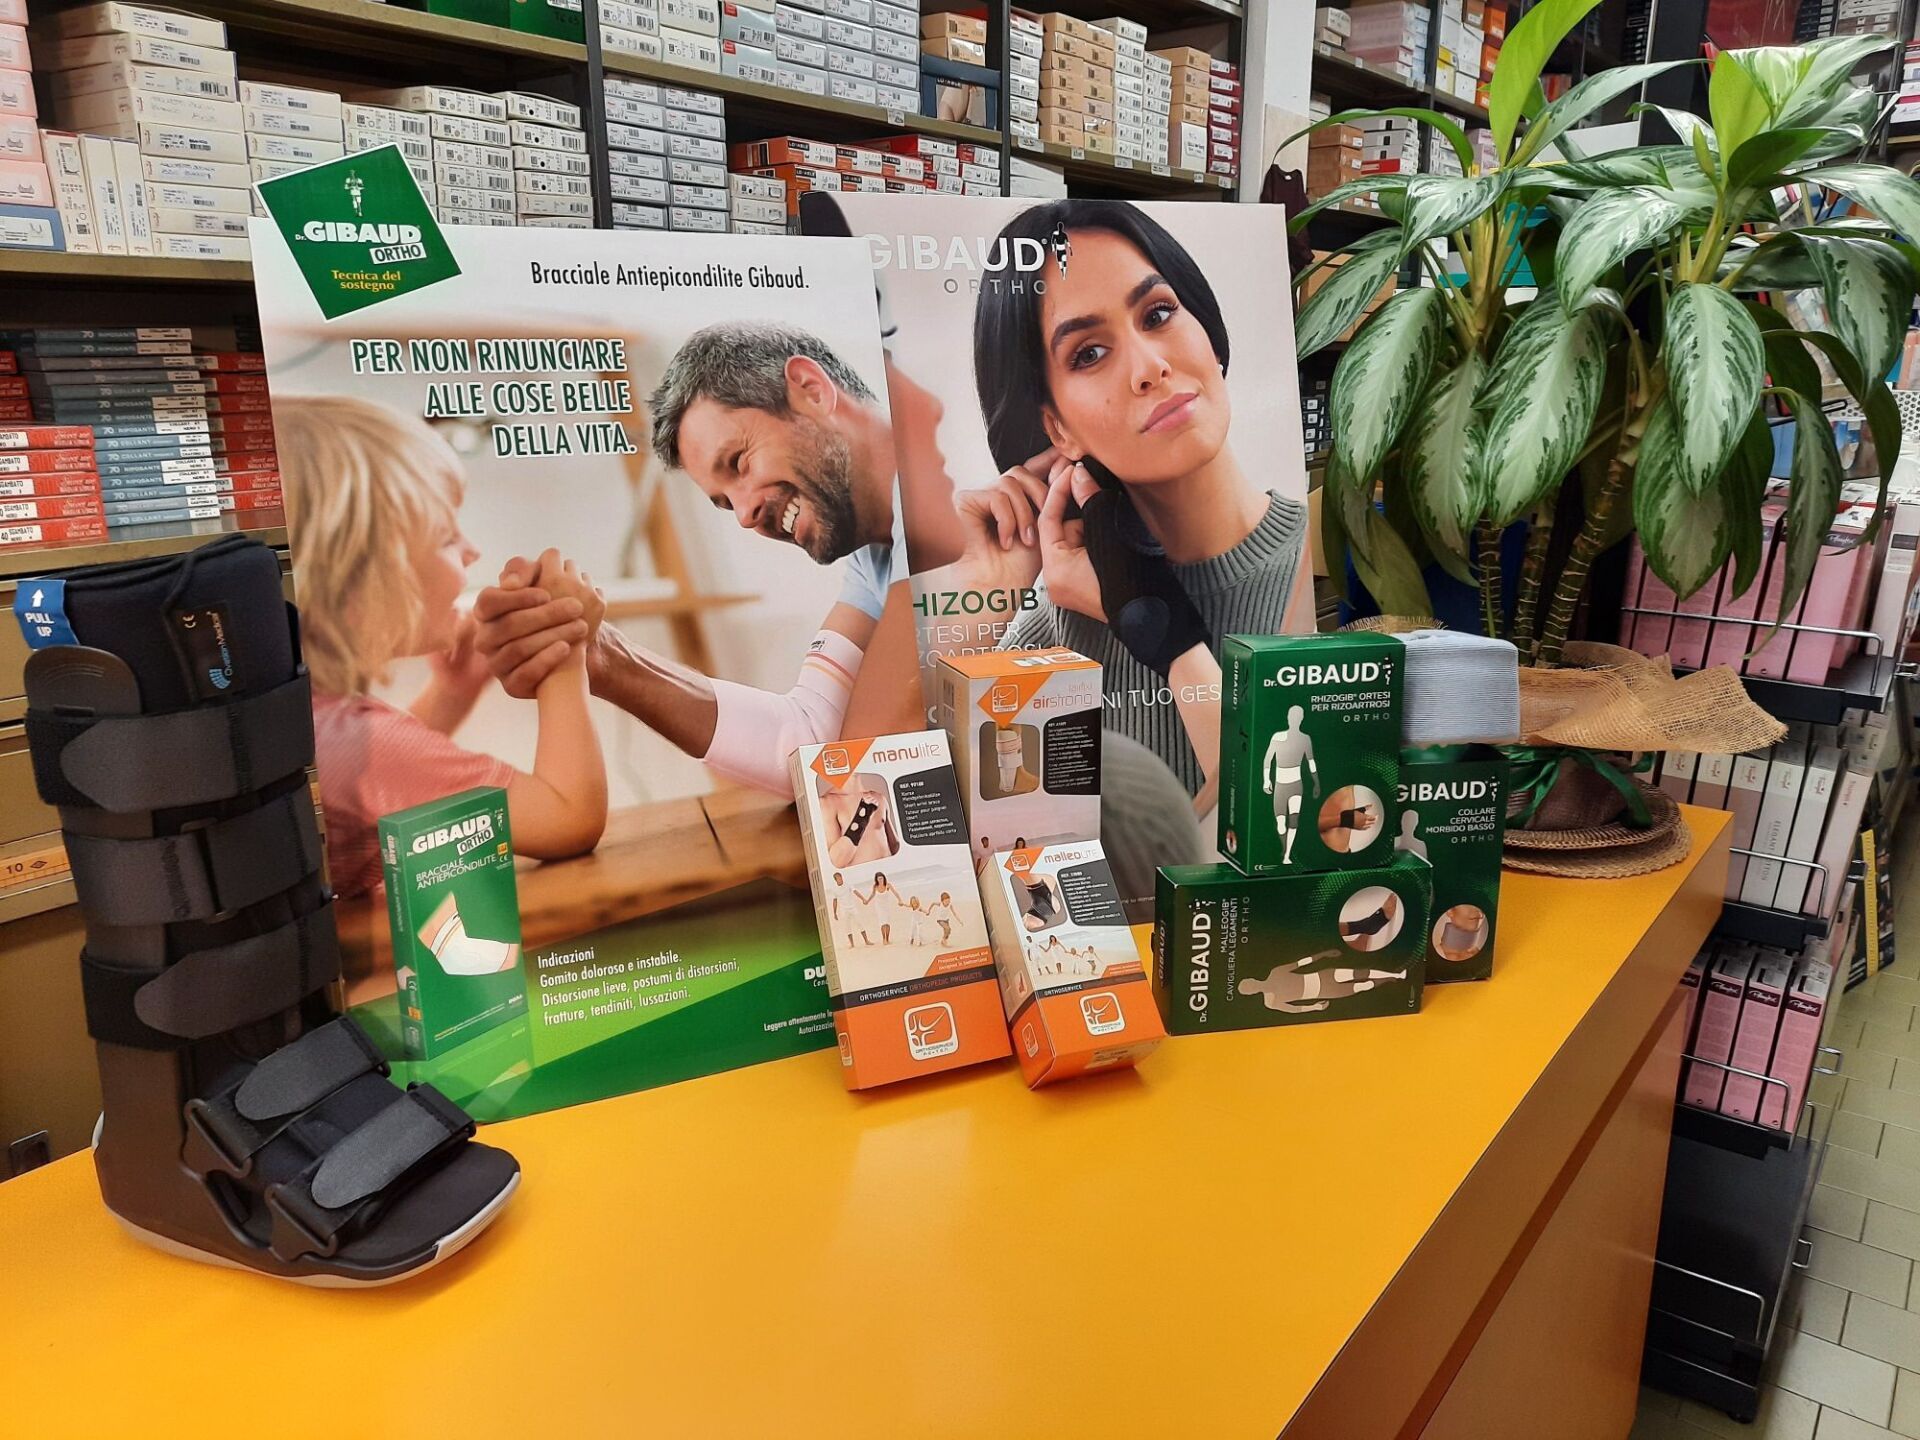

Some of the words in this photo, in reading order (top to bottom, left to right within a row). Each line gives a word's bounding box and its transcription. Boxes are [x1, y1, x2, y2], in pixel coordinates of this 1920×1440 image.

[304, 221, 422, 244] GIBAUD
[374, 244, 422, 262] ORTHO
[864, 233, 1045, 272] GIBAUD
[331, 270, 379, 281] Tecnica
[382, 270, 401, 281] del
[340, 280, 394, 292] sostegno
[531, 262, 610, 286] Bracciale
[616, 264, 742, 292] Antiepicondilite
[748, 266, 810, 290] Gibaud.
[944, 278, 1048, 295] ORTHO
[353, 340, 402, 373] PER
[410, 340, 472, 372] NON
[479, 339, 626, 371] RINUNCIARE
[425, 385, 484, 417] ALLE
[492, 383, 557, 415] COSE
[565, 382, 632, 414] BELLE
[494, 426, 568, 456] DELLA
[575, 424, 637, 455] VITA.
[108, 466, 120, 474] 70
[0, 532, 8, 541] 40
[912, 587, 1039, 617] HIZOGIB
[24, 612, 54, 624] PULL
[37, 626, 52, 637] UP
[977, 621, 1022, 642] PER
[1263, 678, 1278, 688] Dr.
[1276, 662, 1380, 687] GIBAUD
[1033, 693, 1093, 710] airstrong
[1128, 687, 1174, 708] TUO
[1180, 683, 1222, 704] GES
[1311, 702, 1329, 712] PER
[1330, 700, 1390, 712] RIZOARTROSI
[1359, 691, 1391, 701] ORTESI
[1343, 712, 1390, 723] ORTHO
[872, 742, 942, 764] manulite
[1396, 780, 1487, 802] GIBAUD
[1450, 815, 1496, 825] CERVICALE
[1458, 807, 1496, 817] COLLARE
[412, 814, 492, 854] GIBAUD
[1425, 824, 1466, 834] MORBIDO
[1467, 822, 1495, 832] BASSO
[1451, 834, 1494, 844] ORTHO
[460, 829, 492, 853] ORTHO
[6, 862, 24, 874] 10
[416, 857, 465, 883] BRACCIALE
[416, 853, 497, 890] ANTIEPICONDILITE
[1230, 898, 1238, 949] LEGAMENTI
[1241, 896, 1250, 944] ORTHO
[537, 947, 595, 970] Indicazioni
[540, 970, 578, 988] Gomito
[582, 962, 625, 982] doloroso
[628, 962, 634, 972] e
[636, 950, 682, 970] instabile.
[1189, 913, 1211, 1012] GIBAUD
[542, 985, 600, 1008] Distorsione
[603, 980, 630, 999] lieve,
[633, 972, 673, 998] postumi
[675, 967, 686, 982] di
[687, 958, 741, 980] distorsioni,
[804, 966, 826, 980] DU
[1226, 950, 1236, 1002] CAVIGLIERA
[860, 986, 908, 1002] ORTHOSERVICE
[910, 976, 949, 992] ORTHOPEDIC
[1044, 984, 1082, 996] ORTHOSERVICE
[544, 1006, 588, 1026] fratture,
[590, 998, 636, 1017] tendiniti,
[638, 988, 691, 1008] lussazioni.
[764, 1019, 788, 1032] Leggere
[798, 1020, 836, 1035] Autorizzazion
